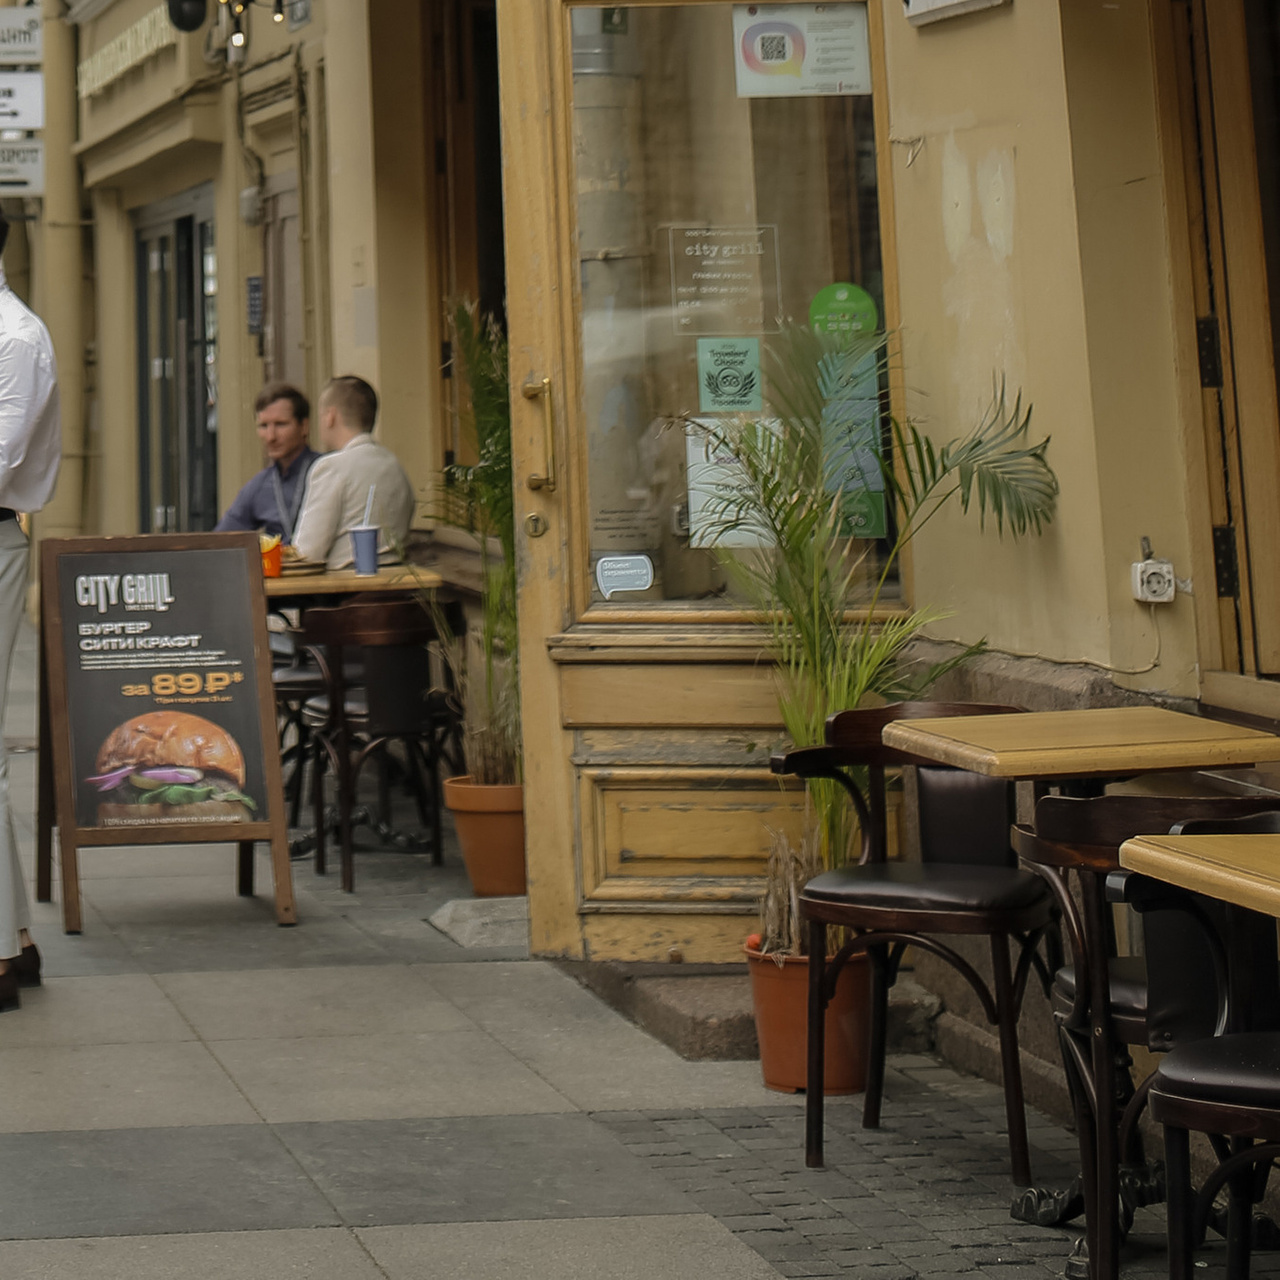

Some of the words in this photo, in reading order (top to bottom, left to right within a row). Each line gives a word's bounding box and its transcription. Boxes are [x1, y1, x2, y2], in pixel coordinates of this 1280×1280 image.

[685, 243, 719, 258] city
[722, 242, 765, 258] grill
[76, 575, 120, 613] CITY
[122, 573, 175, 611] GRILL
[78, 621, 152, 635] БУРГЕР
[79, 638, 134, 651] СИТИ
[136, 634, 202, 648] КРАФТ
[121, 684, 151, 697] за
[151, 672, 203, 696] 89
